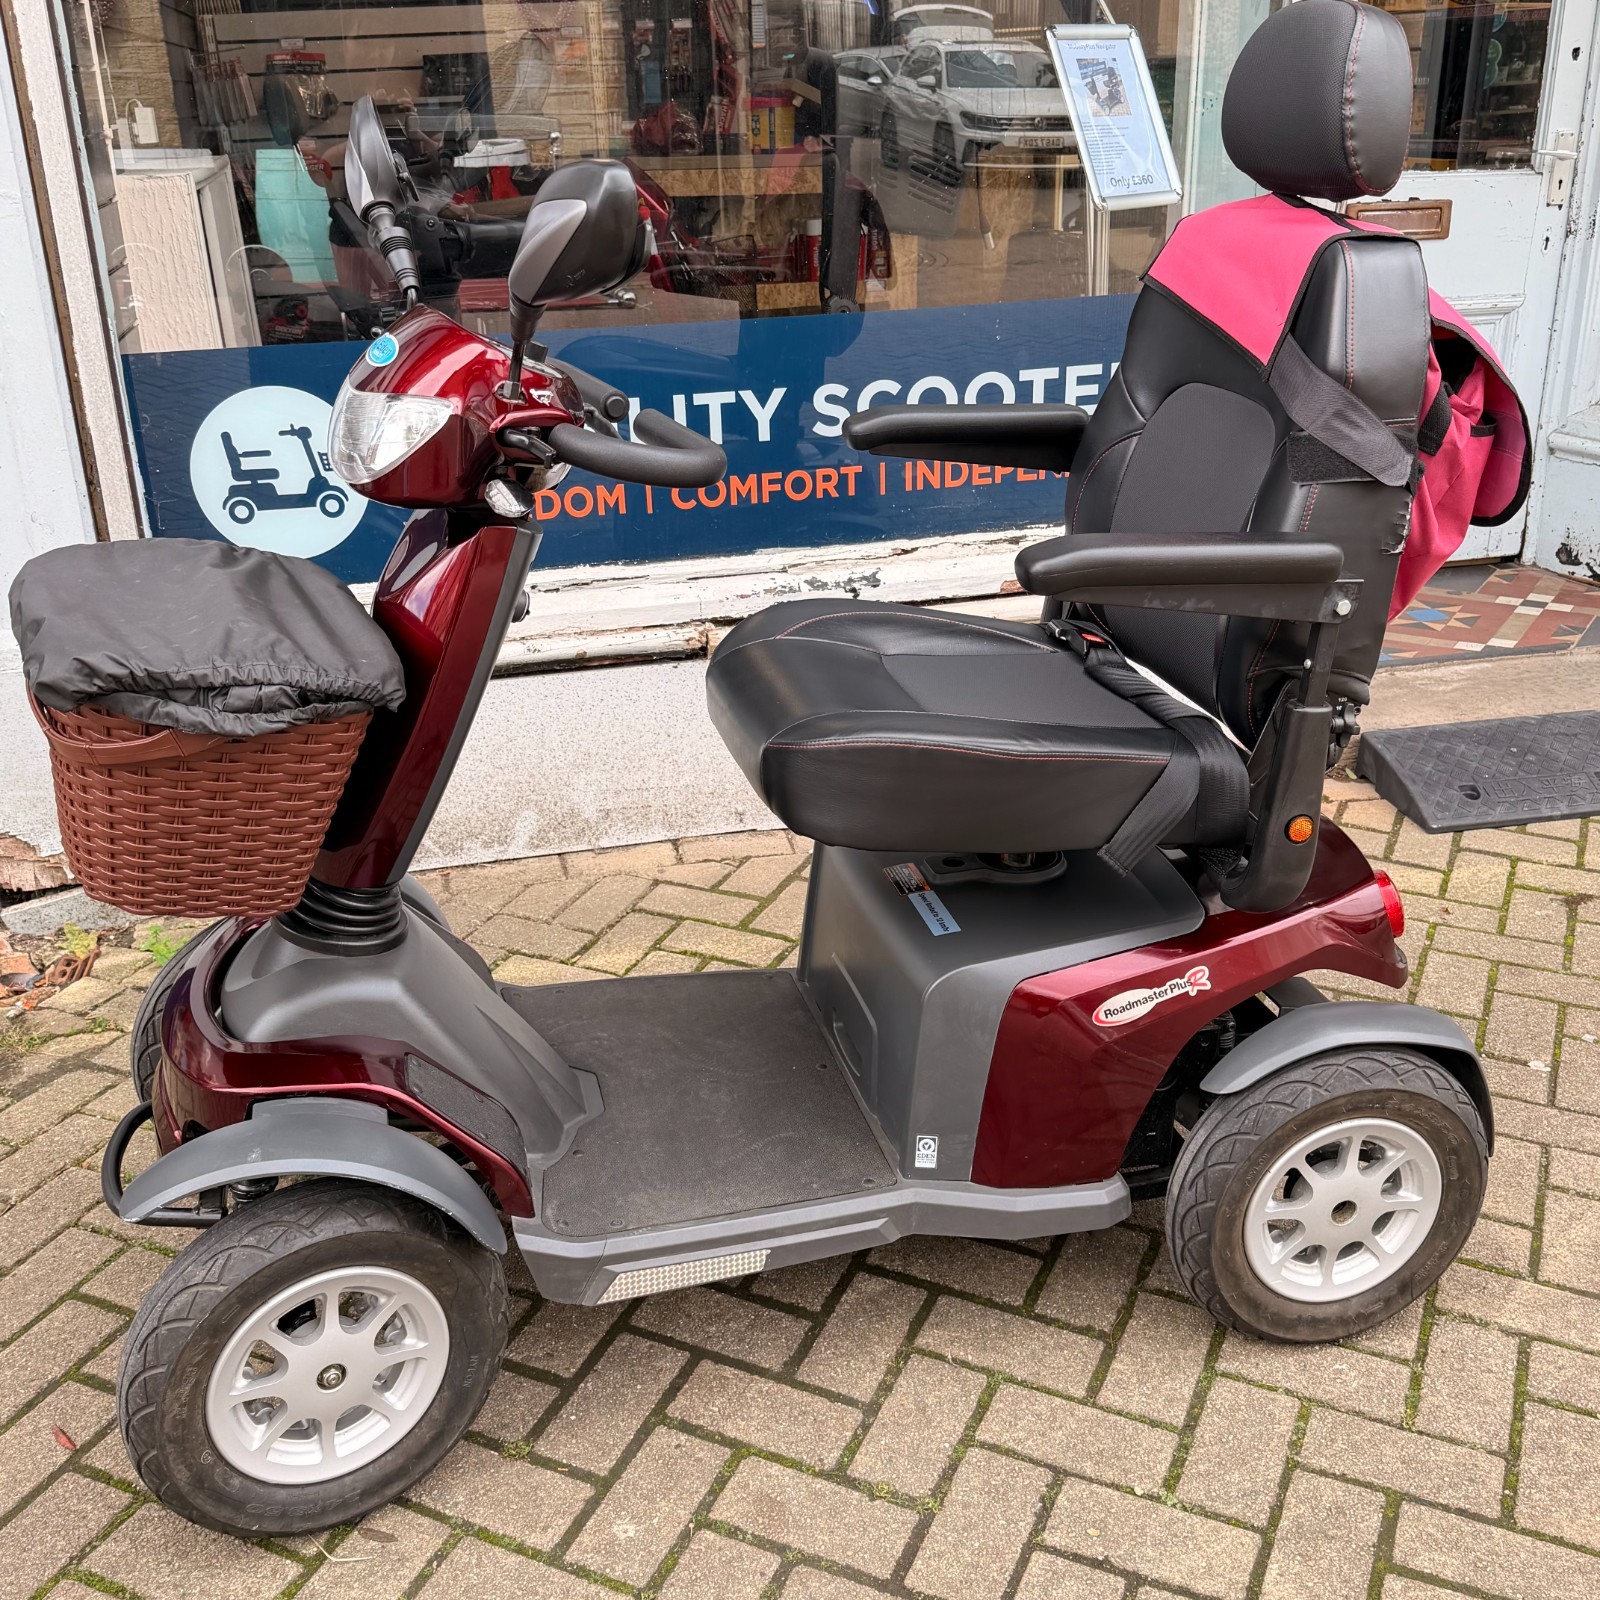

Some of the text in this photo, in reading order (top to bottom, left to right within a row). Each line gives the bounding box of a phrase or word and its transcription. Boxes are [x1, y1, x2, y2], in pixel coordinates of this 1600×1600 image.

[1110, 175, 1154, 189] Only £360
[812, 362, 1120, 438] SCOOTE
[671, 465, 863, 511] COMFORT
